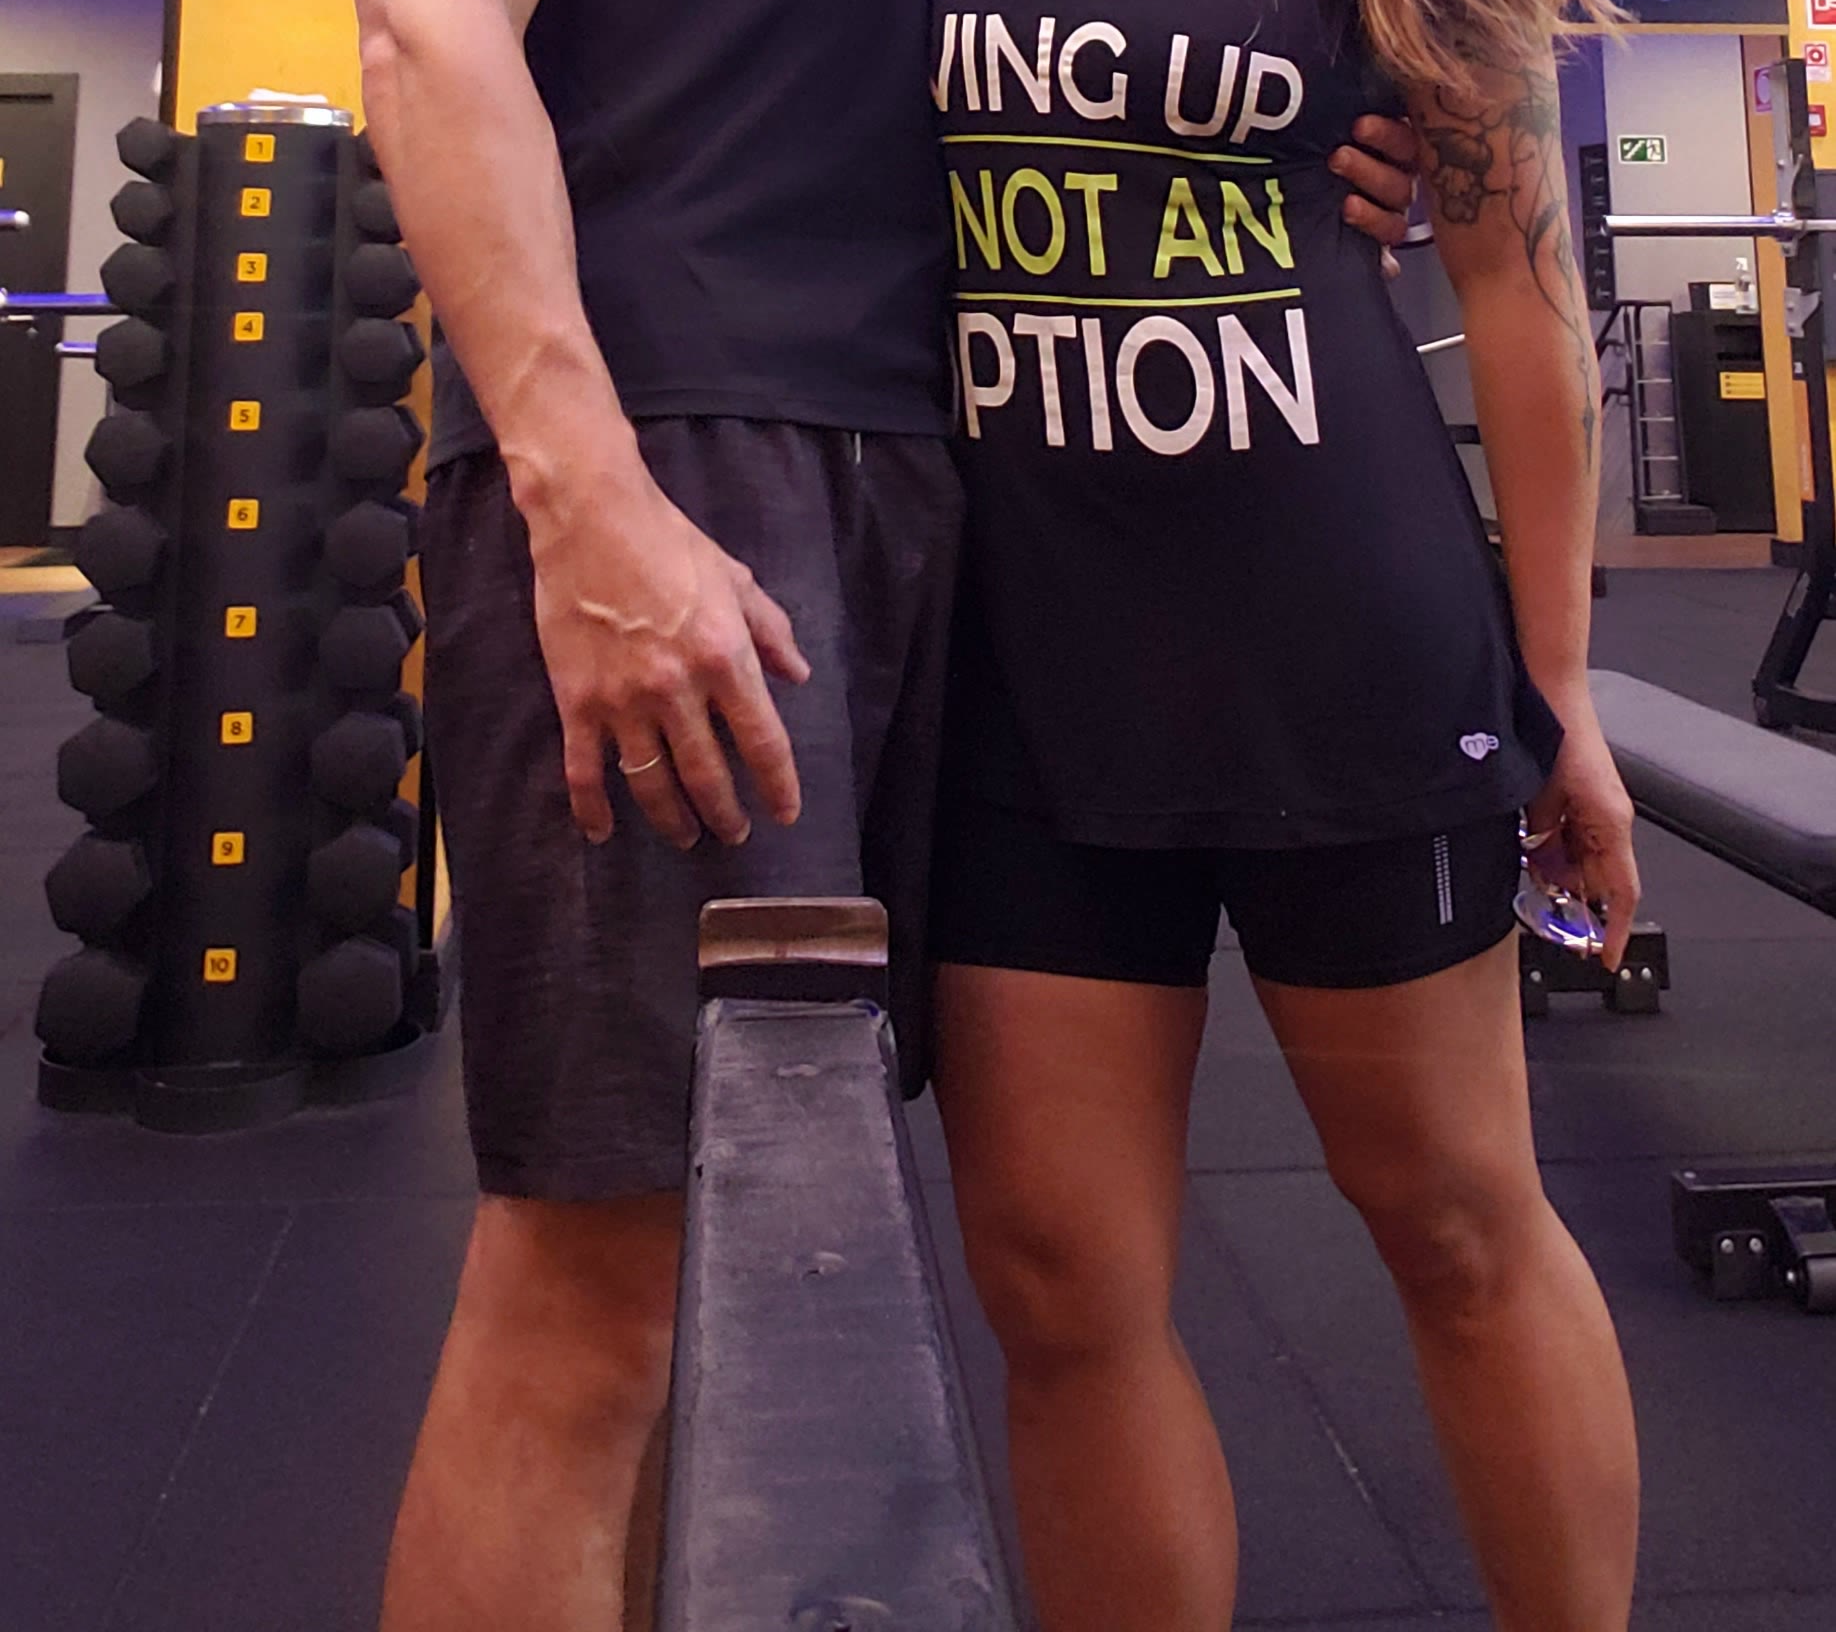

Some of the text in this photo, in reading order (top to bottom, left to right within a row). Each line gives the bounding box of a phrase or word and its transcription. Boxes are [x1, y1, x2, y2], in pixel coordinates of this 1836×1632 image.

[1164, 34, 1303, 144] UP
[250, 195, 261, 210] 2
[949, 167, 1295, 279] NOT AN
[246, 261, 257, 275] 3
[242, 320, 254, 333] 4
[239, 408, 251, 423] 5
[236, 506, 248, 521] 6
[234, 615, 246, 629] 7
[231, 721, 242, 736] 8
[221, 841, 233, 856] 9
[209, 957, 229, 973] 10
